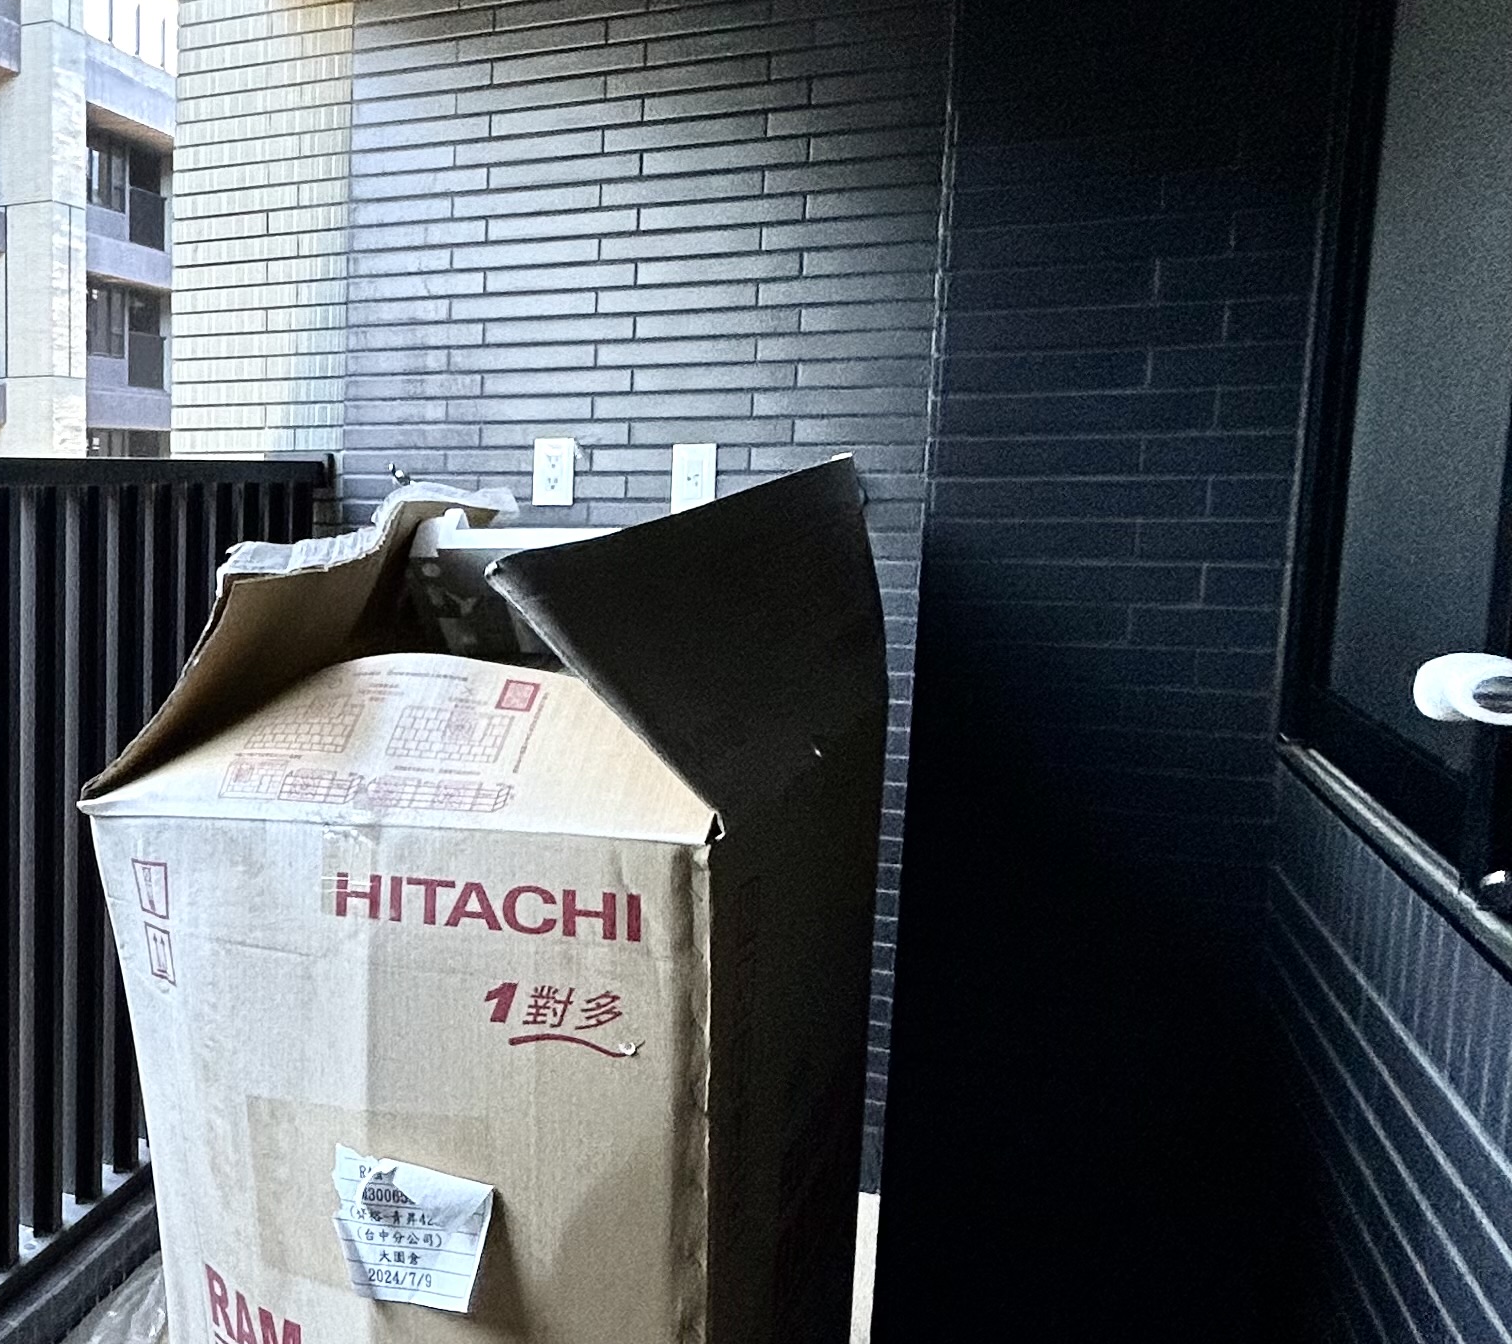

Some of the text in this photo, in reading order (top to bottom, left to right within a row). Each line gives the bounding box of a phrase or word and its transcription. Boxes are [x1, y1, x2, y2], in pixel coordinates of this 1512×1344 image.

[335, 871, 642, 942] HITACHI
[484, 981, 623, 1030] 1對多
[368, 1268, 432, 1288] 2024/7/9
